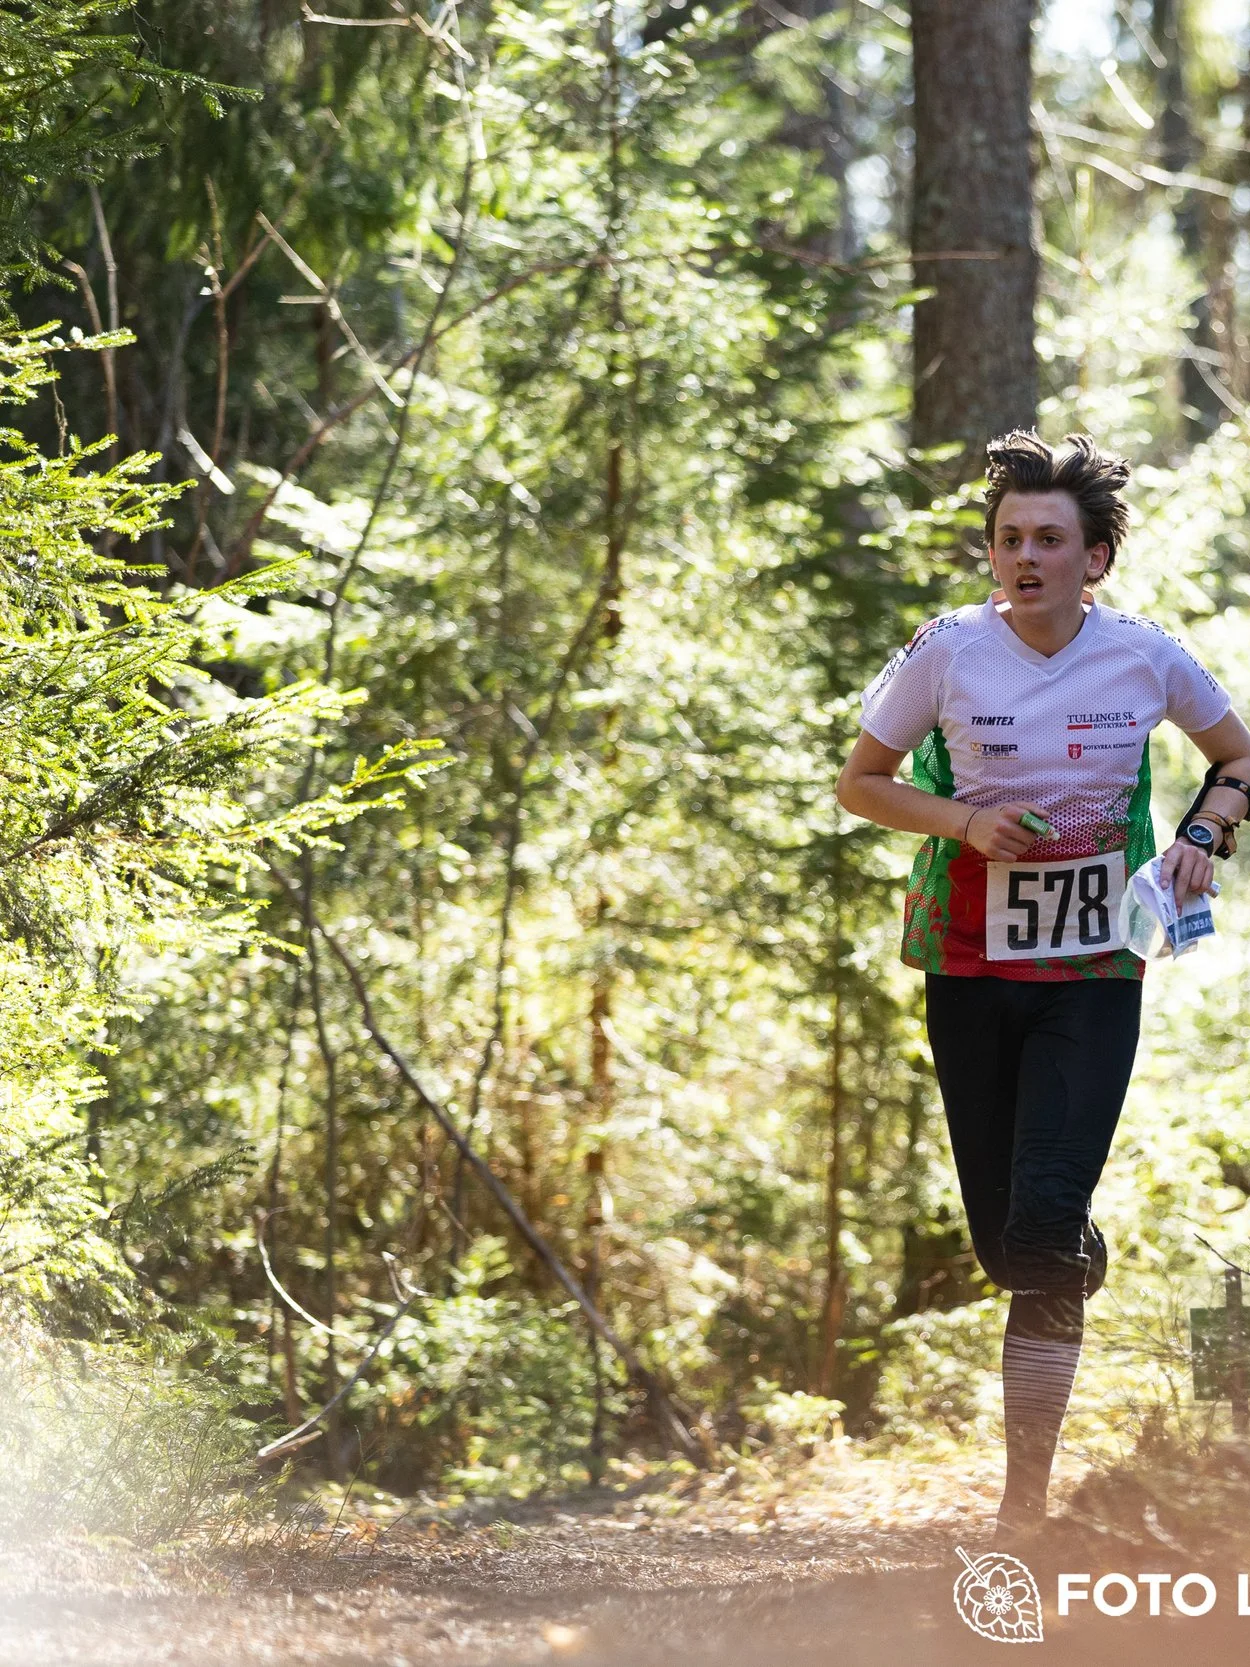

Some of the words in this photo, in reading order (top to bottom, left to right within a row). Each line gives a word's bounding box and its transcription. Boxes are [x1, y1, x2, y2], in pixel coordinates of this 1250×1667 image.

[971, 716, 1016, 726] TRIMTEX
[1067, 712, 1121, 724] TULLINGE
[1122, 711, 1137, 721] SK
[1093, 721, 1128, 730] BOTKYRKA
[1007, 863, 1111, 951] 578
